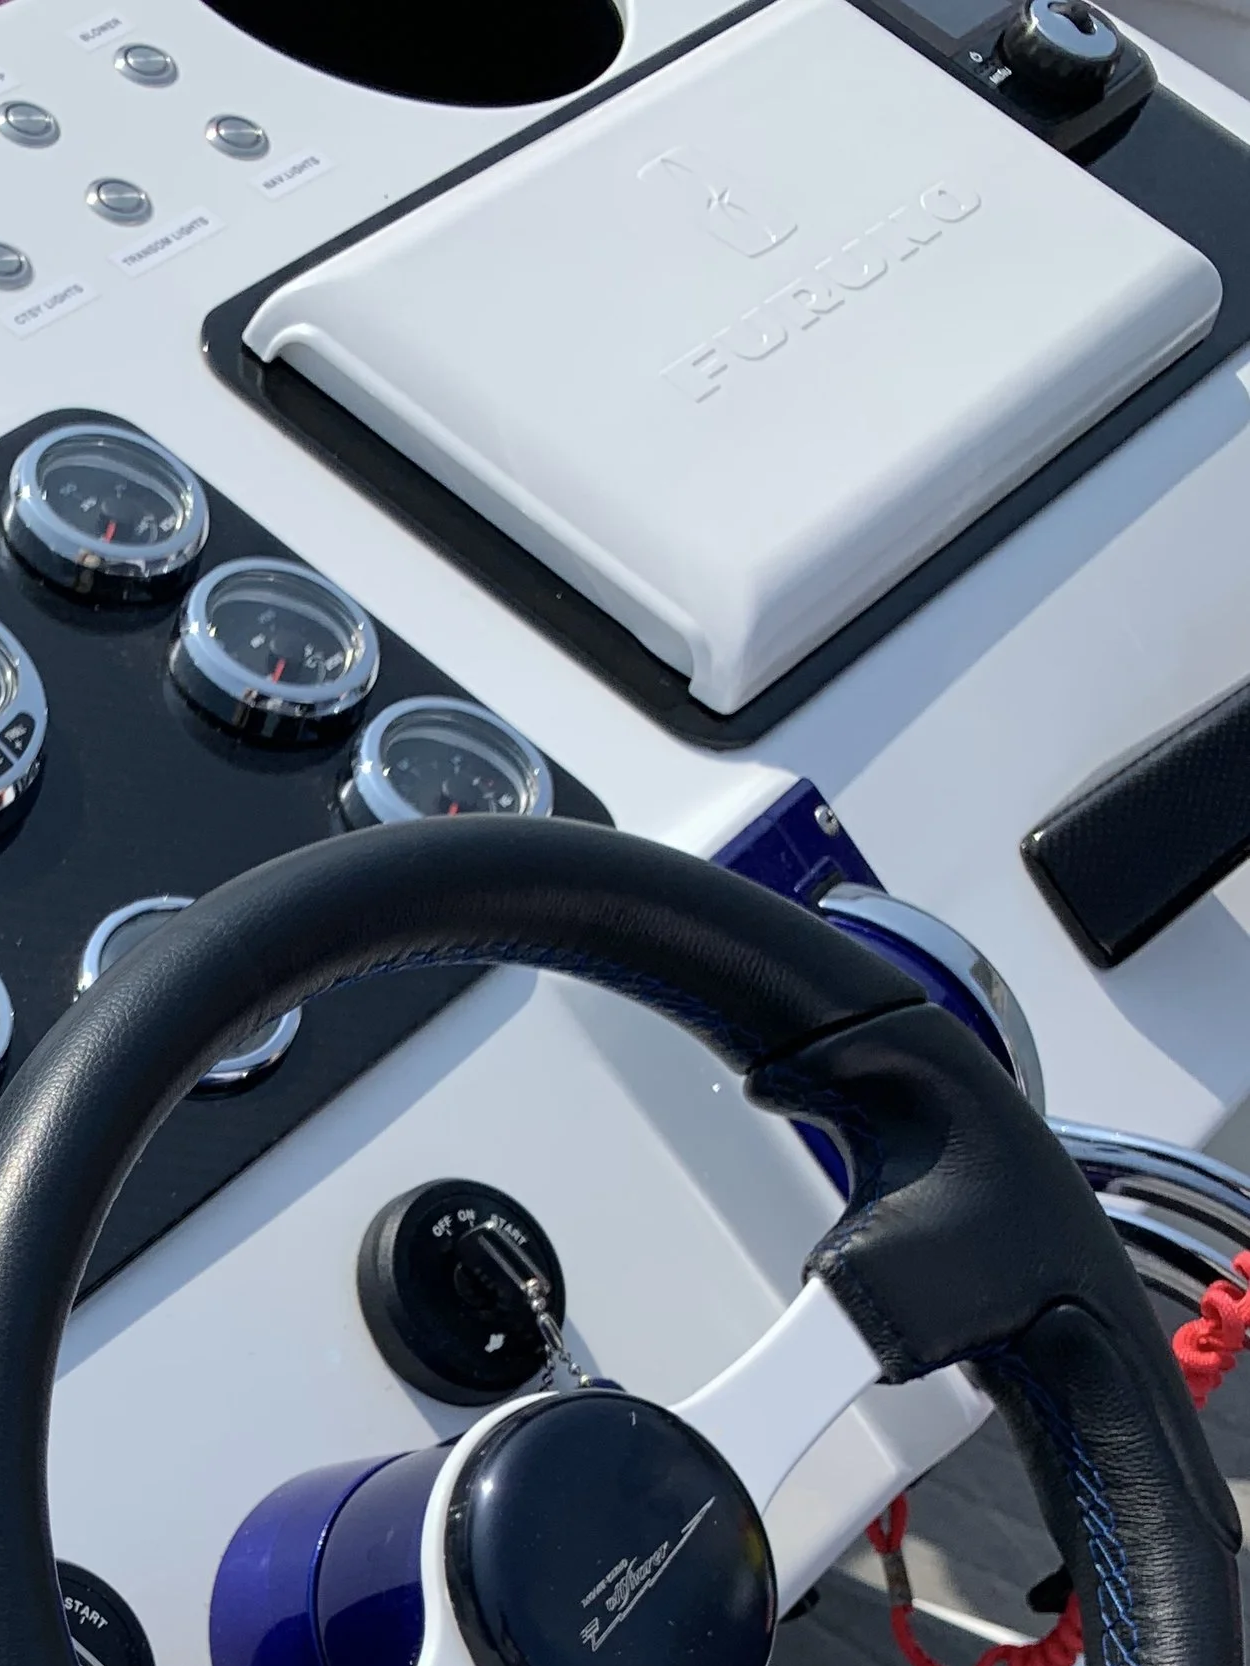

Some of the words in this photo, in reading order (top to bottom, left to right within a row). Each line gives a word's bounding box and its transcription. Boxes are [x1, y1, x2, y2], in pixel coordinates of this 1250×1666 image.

[79, 18, 122, 42] BLOWER
[121, 236, 173, 267] TRANSOM
[172, 215, 209, 242] LIGHTS
[14, 303, 43, 326] CTSY
[44, 283, 84, 312] LIGHTS
[659, 180, 982, 403] FURUNO
[432, 1214, 453, 1237] OFF
[457, 1208, 476, 1222] ON
[490, 1213, 528, 1246] START
[64, 1596, 108, 1629] START
